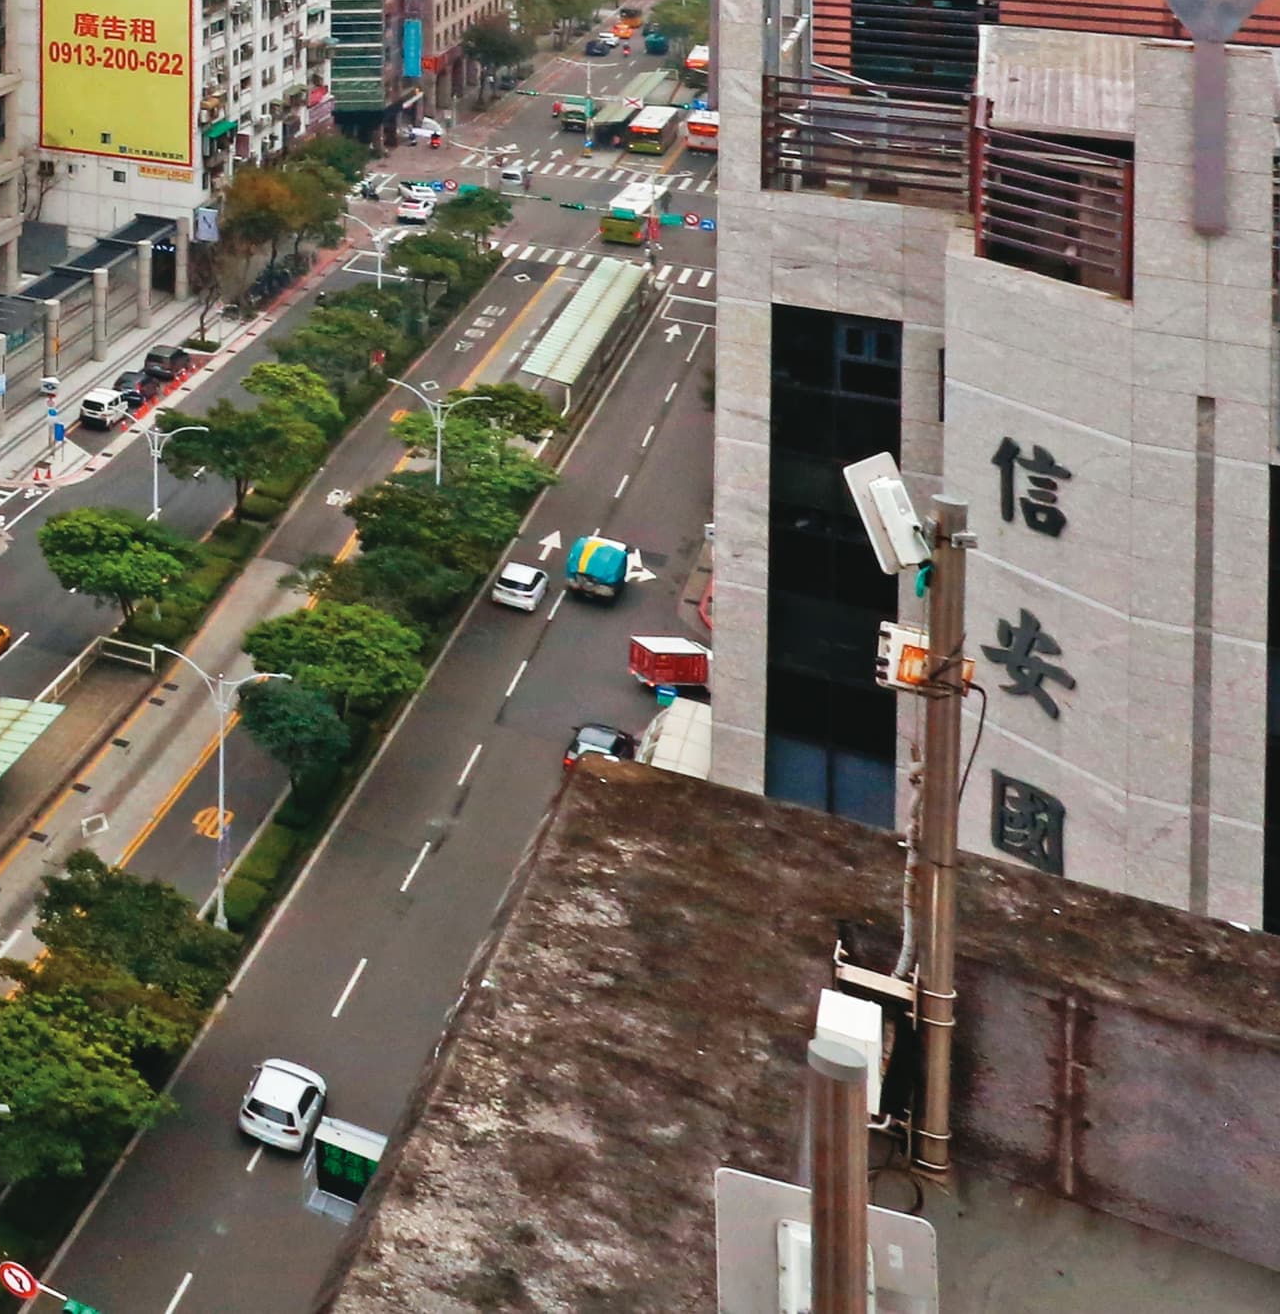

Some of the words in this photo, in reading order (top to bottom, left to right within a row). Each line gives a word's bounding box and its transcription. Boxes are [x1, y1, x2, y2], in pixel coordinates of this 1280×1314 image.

[73, 12, 157, 45] 廣告租
[48, 41, 184, 76] 0913-200-622
